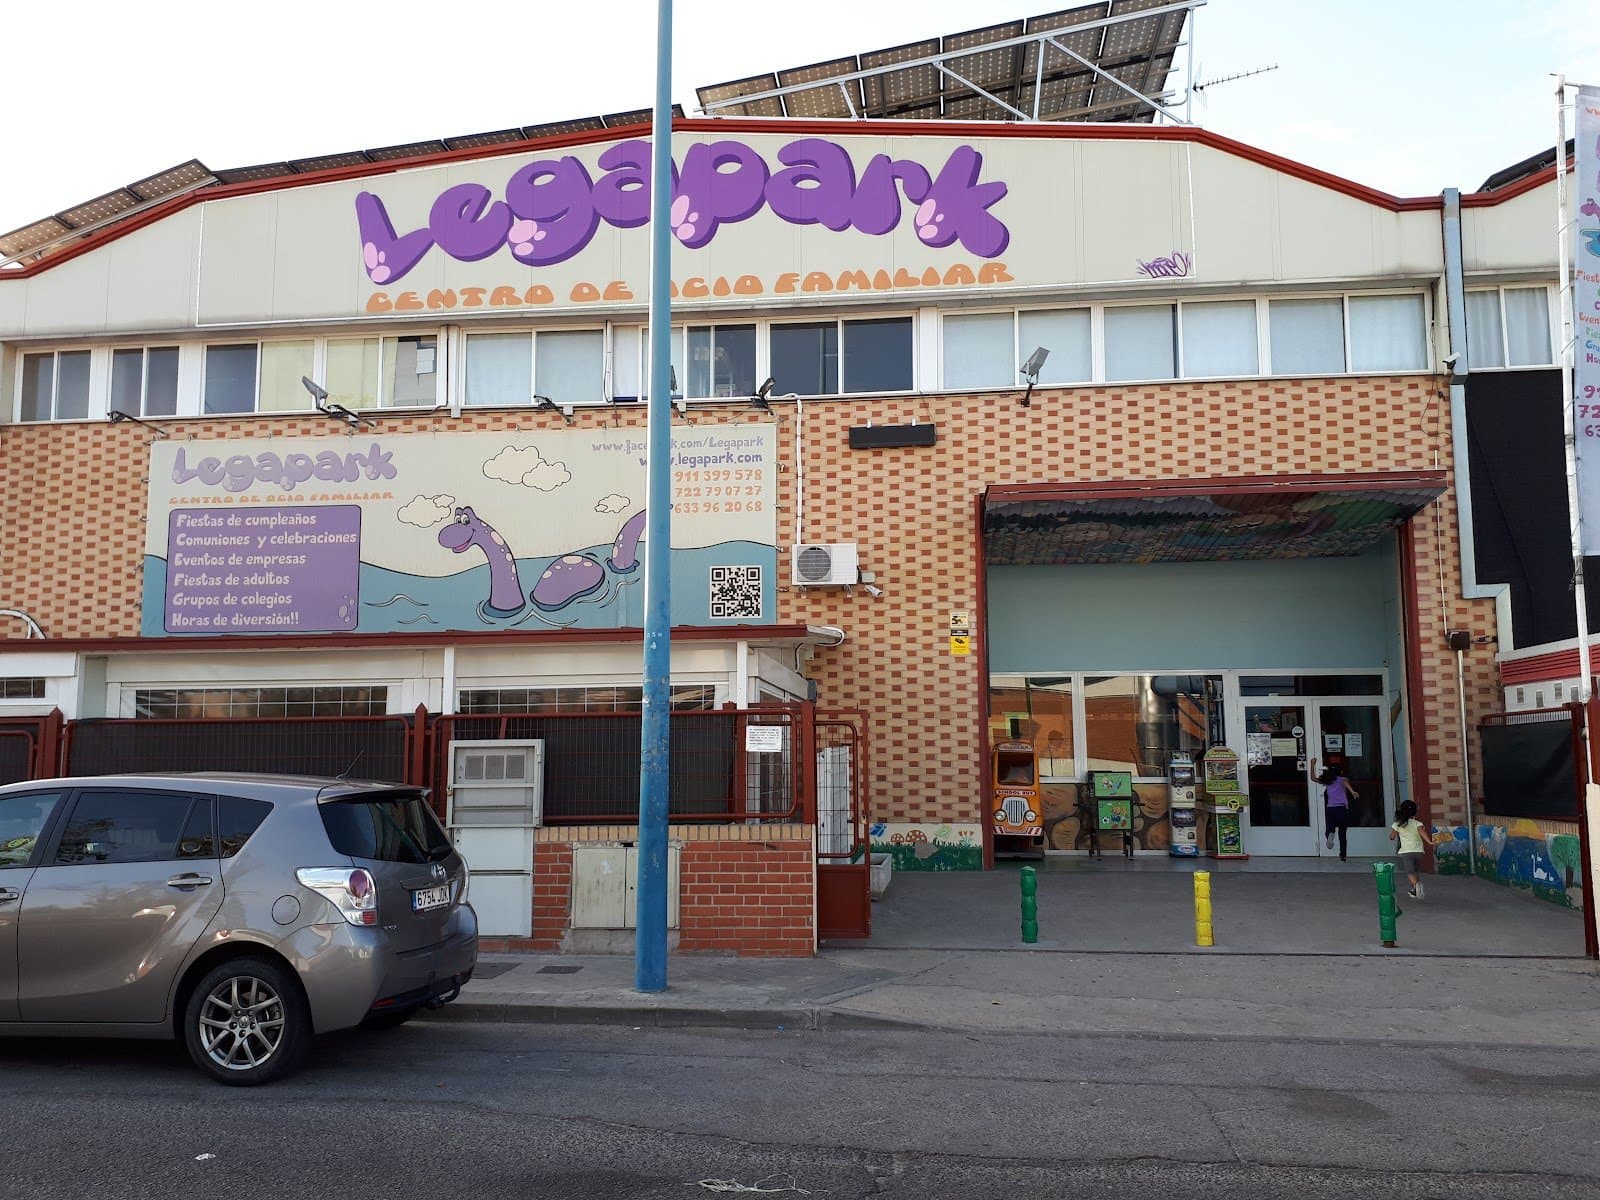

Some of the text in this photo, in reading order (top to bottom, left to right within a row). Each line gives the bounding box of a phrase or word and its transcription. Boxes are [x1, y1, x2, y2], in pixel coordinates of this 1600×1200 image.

[355, 138, 1010, 286] Legapark
[366, 262, 1015, 313] CENTRO DE CIO FAMILIAR
[171, 442, 398, 493] Legapark
[674, 469, 762, 482] 911 399 578
[168, 495, 233, 505] CENTRO
[239, 494, 261, 504] DE
[310, 491, 394, 502] FAMILIAR
[674, 485, 762, 497] 722 79 07 27
[674, 500, 762, 513] 633 96 20 68
[175, 512, 317, 529] Fiestas de cumpleaños
[176, 531, 358, 549] Comuniones y celebraciones
[174, 552, 307, 568] Eventos de empresas
[173, 570, 290, 587] Fiestas de adultos
[172, 591, 293, 609] Grupos de colegios
[171, 611, 300, 627] Horas de diversión!!
